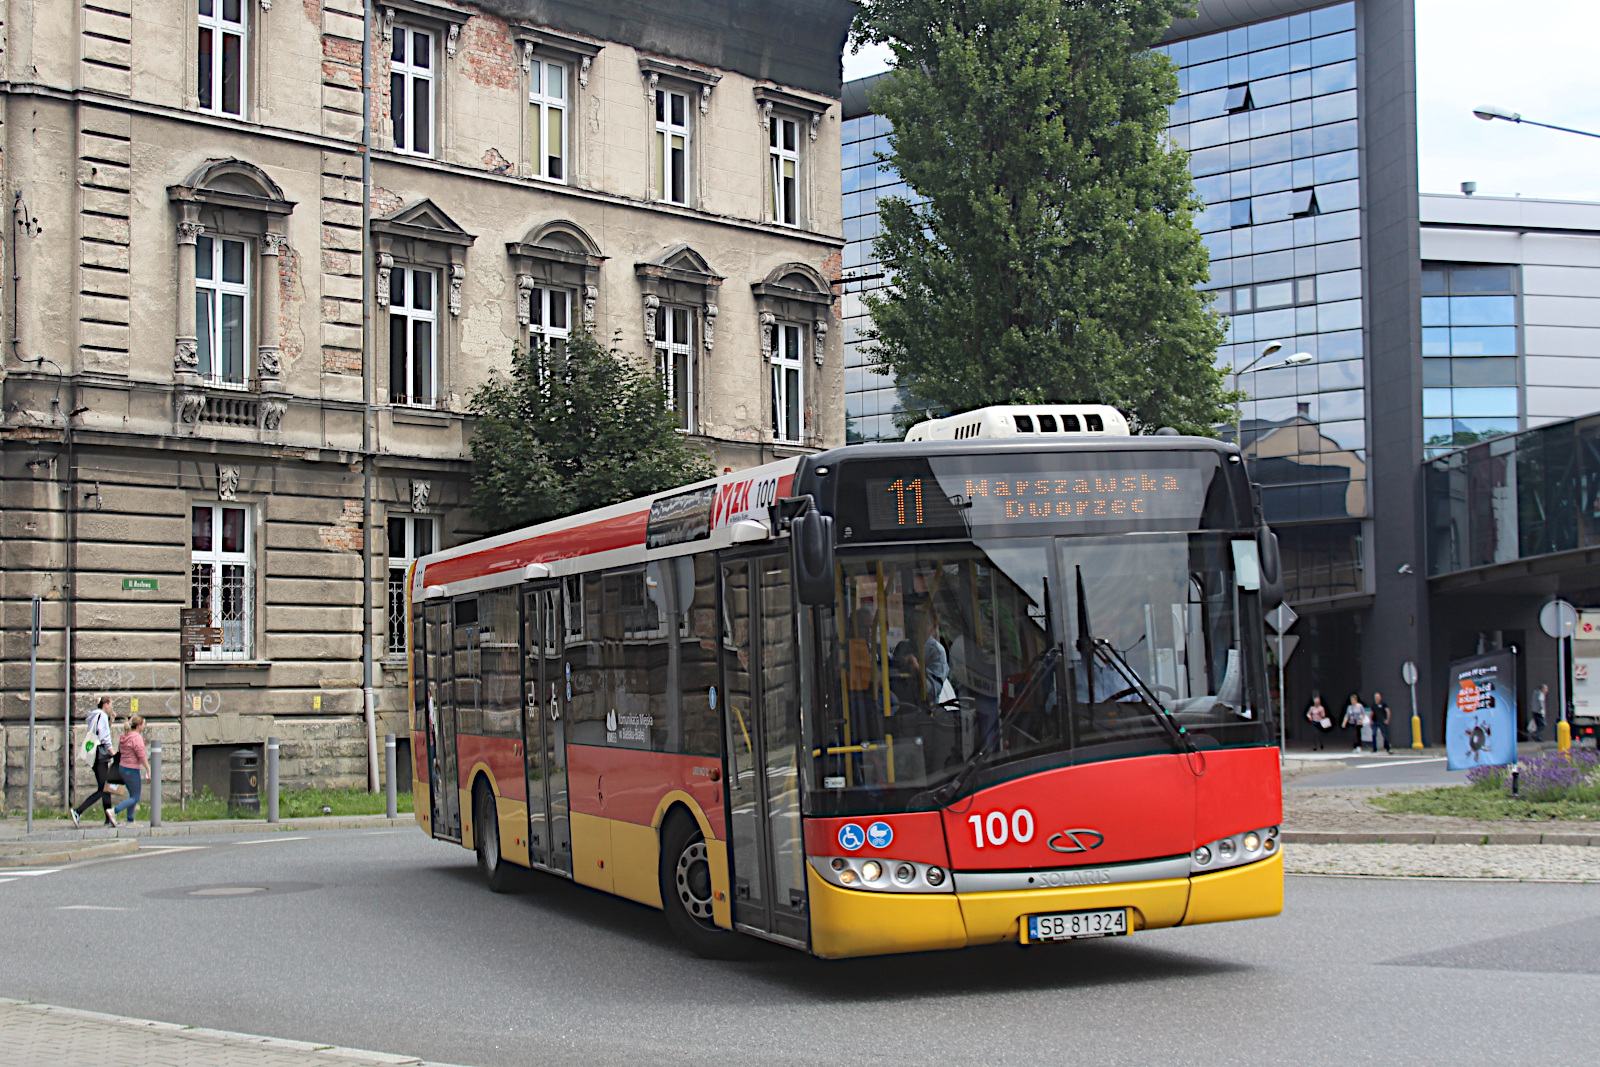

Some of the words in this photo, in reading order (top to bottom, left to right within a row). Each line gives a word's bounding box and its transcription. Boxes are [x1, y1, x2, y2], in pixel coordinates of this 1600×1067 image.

[756, 478, 775, 508] 100
[966, 474, 1180, 497] Warszawska
[888, 478, 923, 524] 11
[1006, 499, 1144, 518] Dworzec
[968, 809, 1034, 847] 100
[1039, 870, 1110, 888] SOLARIS
[1040, 917, 1064, 936] SB
[1072, 912, 1123, 933] 81324
